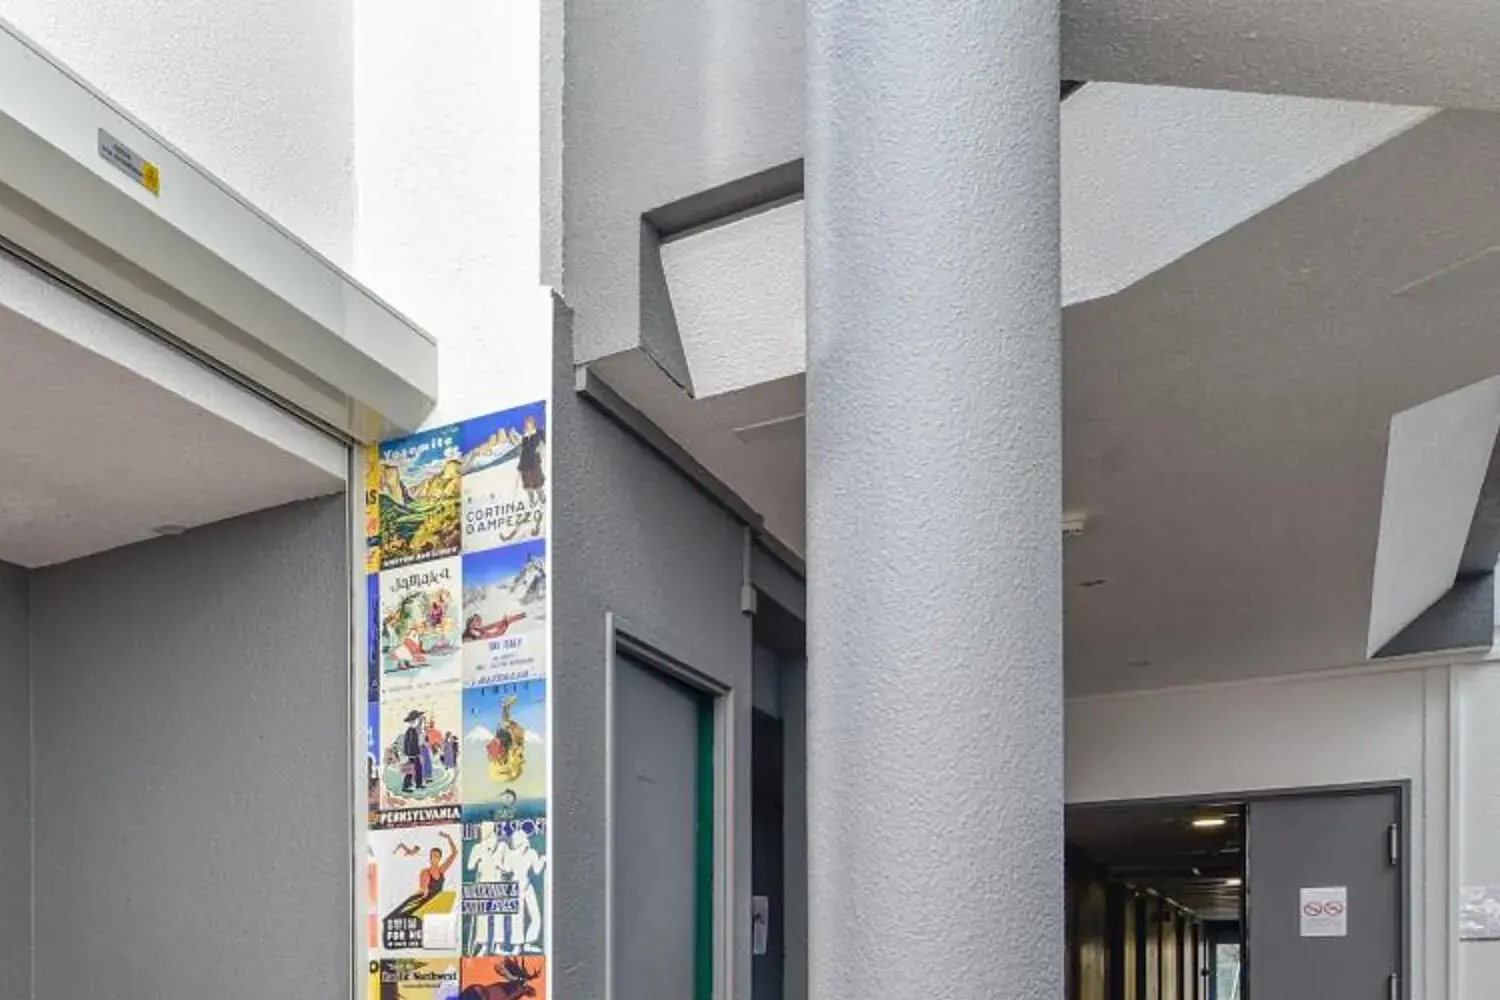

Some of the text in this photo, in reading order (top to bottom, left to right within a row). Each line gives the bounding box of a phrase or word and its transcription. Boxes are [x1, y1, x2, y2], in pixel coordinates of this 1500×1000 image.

[466, 501, 525, 522] CORTINA
[380, 806, 460, 824] PENNSYLVANIA
[387, 931, 405, 941] FOR
[413, 970, 458, 981] Northwest
